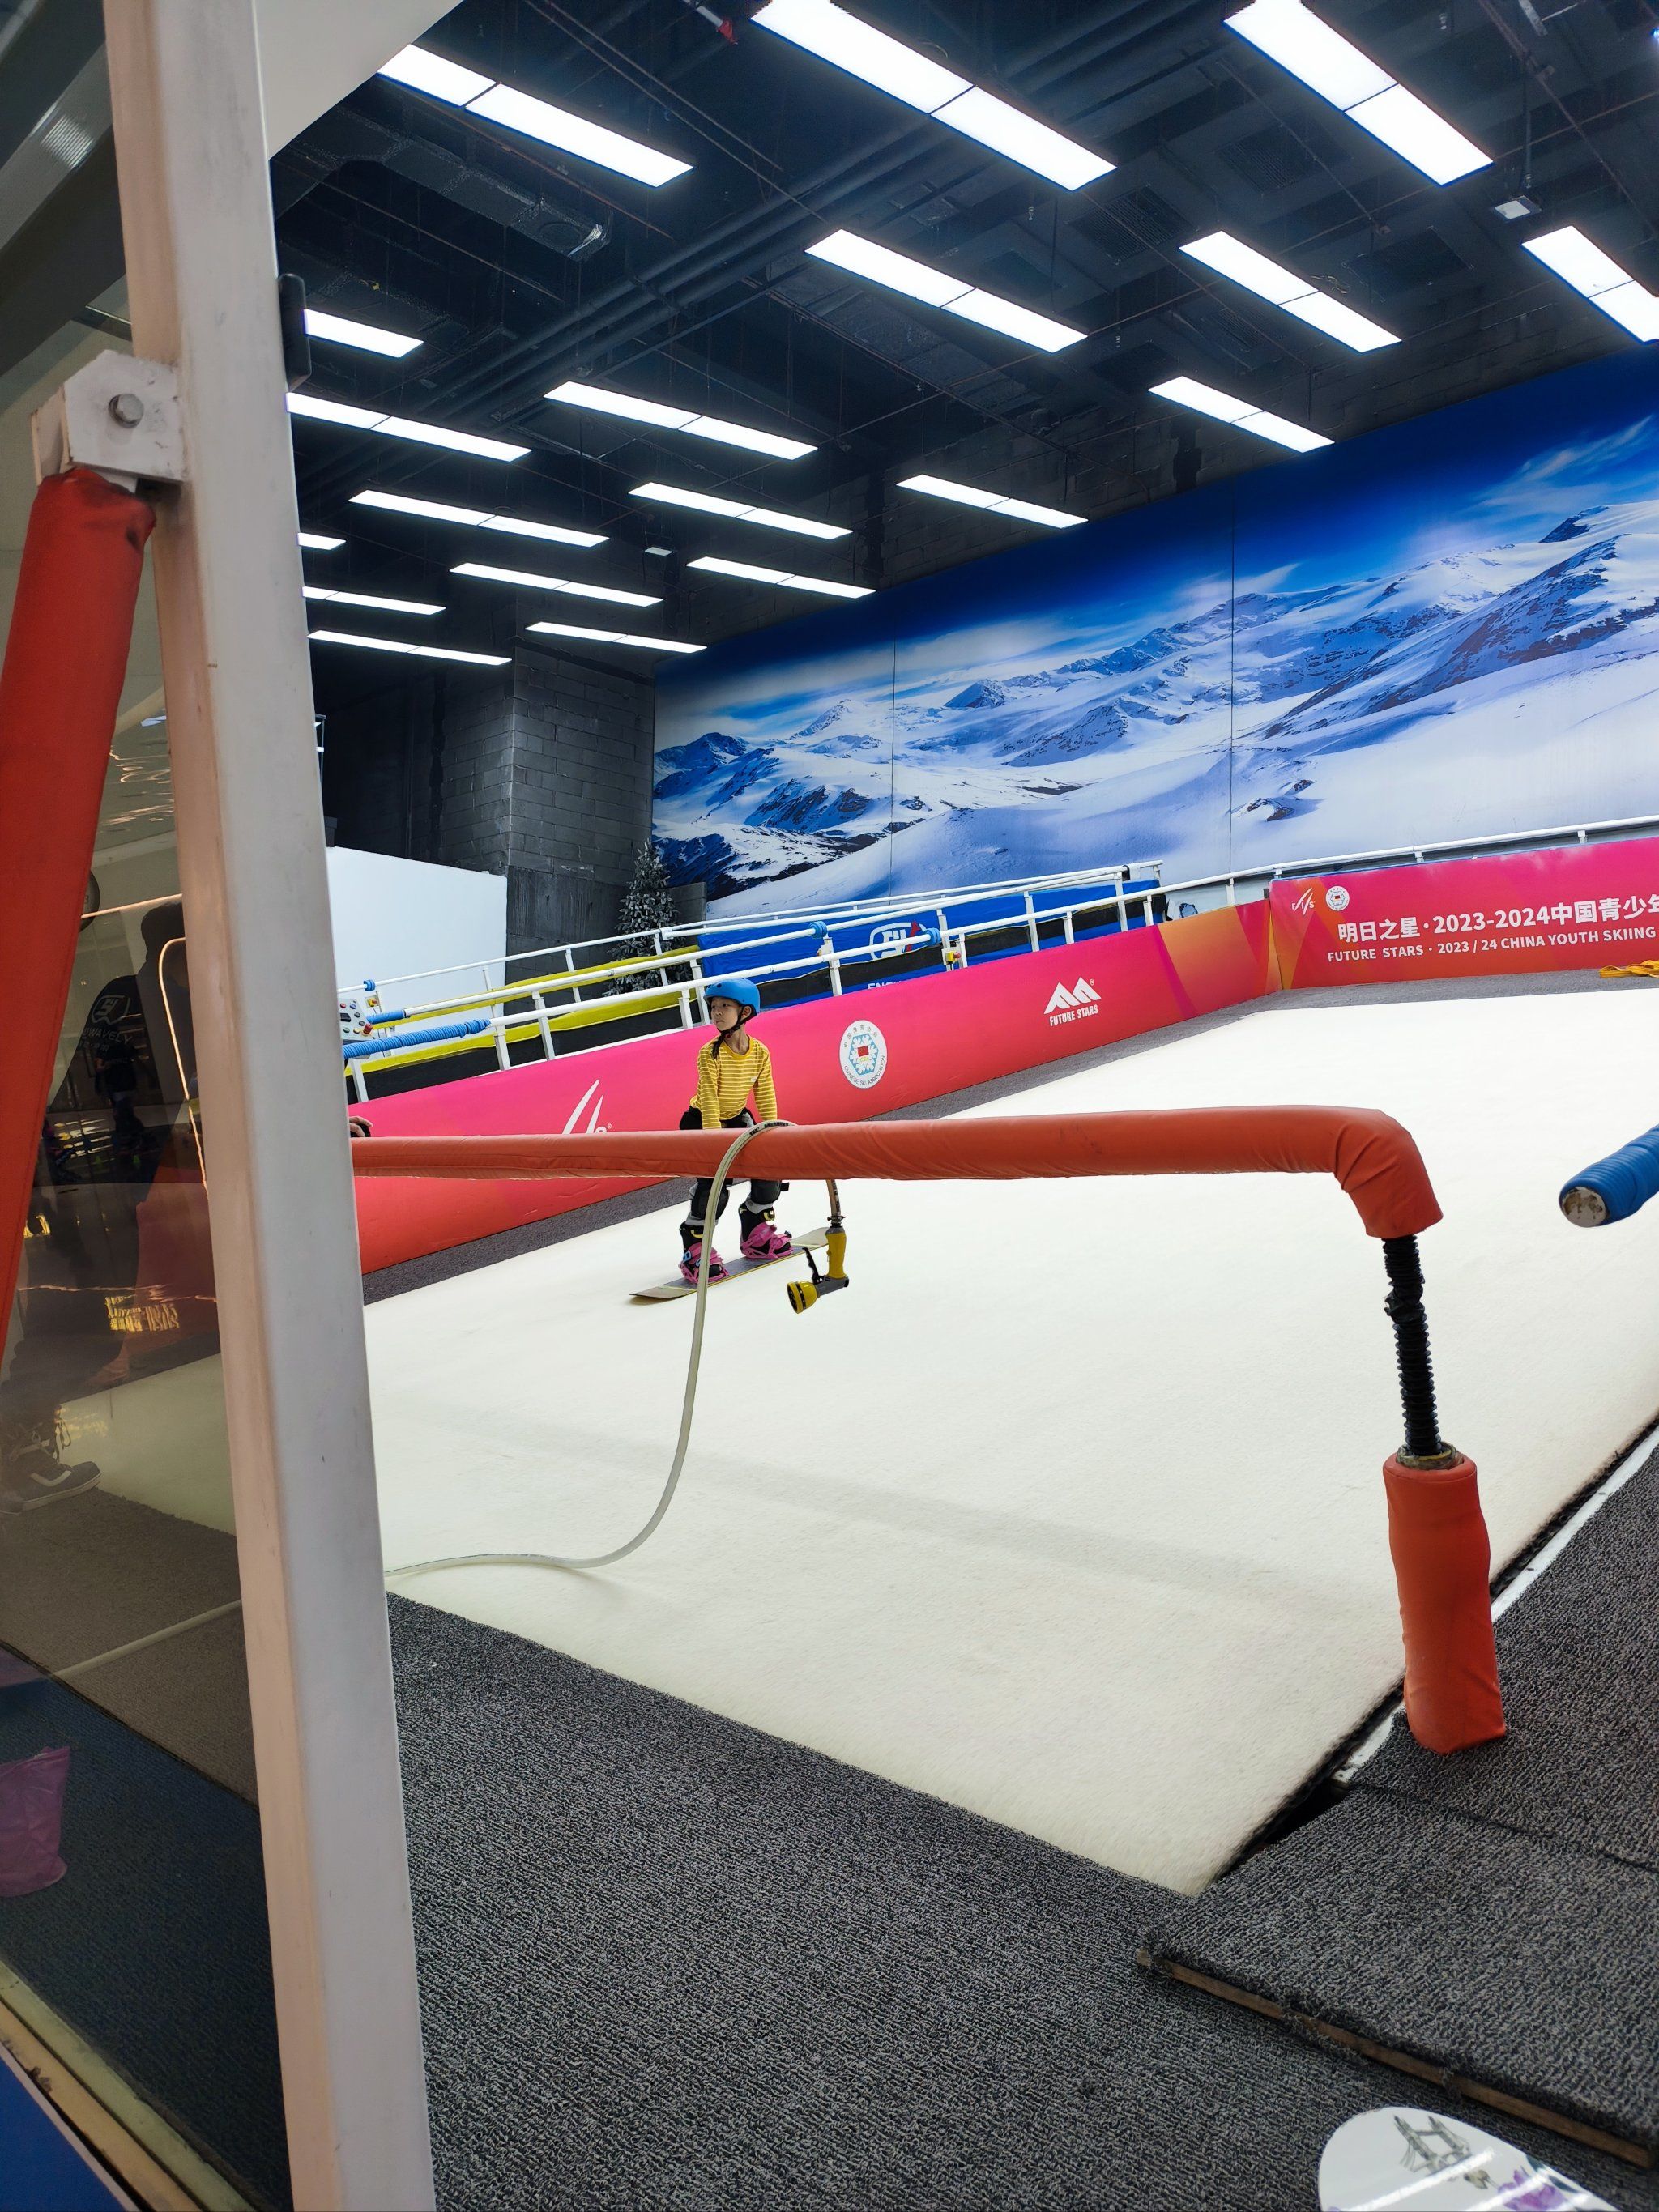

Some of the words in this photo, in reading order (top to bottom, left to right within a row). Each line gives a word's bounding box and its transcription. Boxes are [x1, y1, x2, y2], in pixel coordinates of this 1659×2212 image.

[1327, 948, 1376, 961] FUTURE
[1382, 944, 1423, 957] STARS
[1437, 941, 1469, 954] 2023
[1481, 938, 1498, 951] 24
[1500, 935, 1546, 949] CHINA
[1547, 931, 1599, 945] YOUTH
[1603, 926, 1656, 941] SKIING
[1049, 1011, 1076, 1027] FUTURE
[1077, 1004, 1098, 1019] STARS
